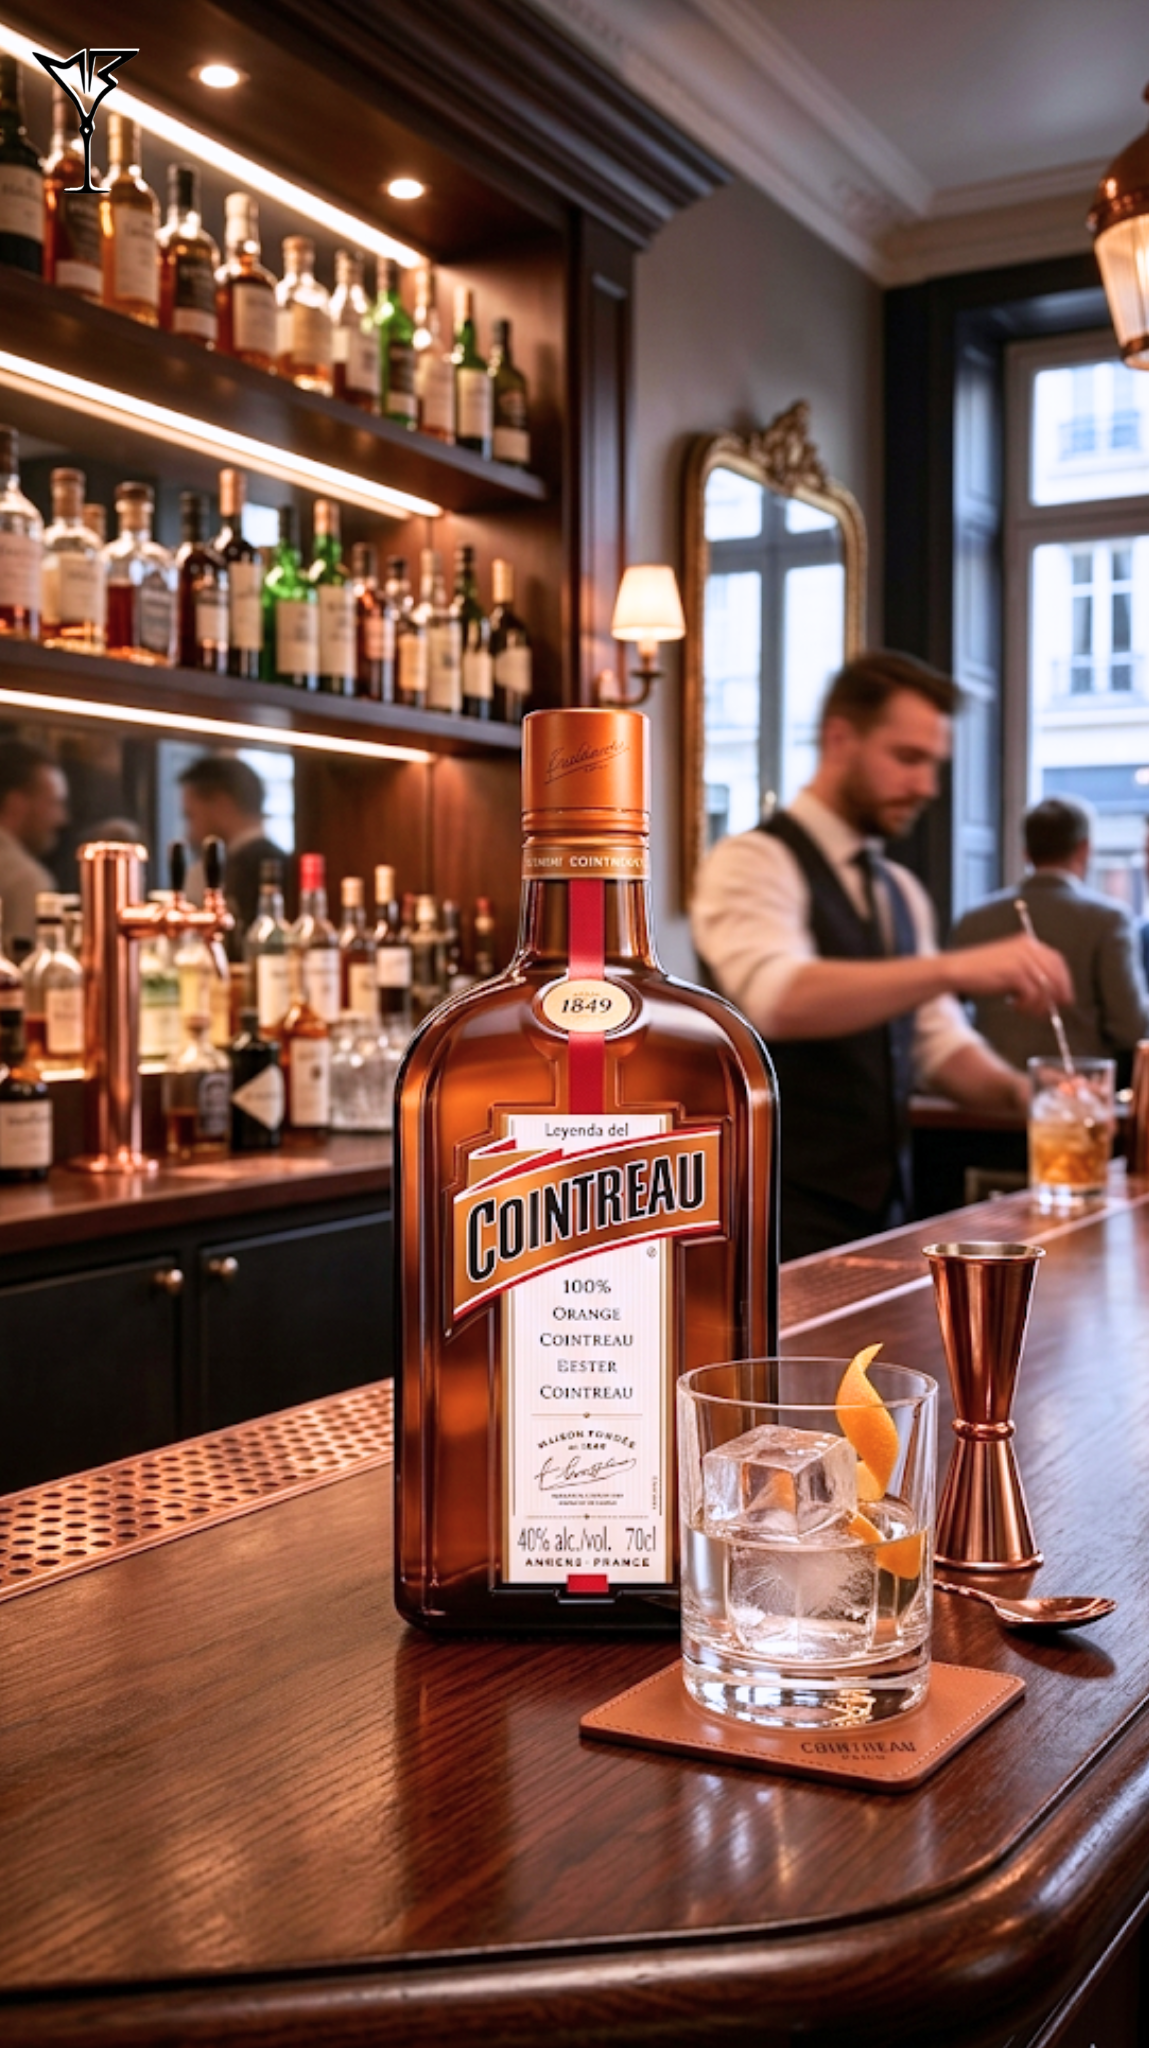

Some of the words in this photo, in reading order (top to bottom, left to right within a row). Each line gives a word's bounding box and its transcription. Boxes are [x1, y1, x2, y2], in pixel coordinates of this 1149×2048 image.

[562, 998, 612, 1014] 1849
[545, 1123, 603, 1141] Leyenda
[608, 1122, 629, 1137] del
[467, 1150, 705, 1283] COINTREAU
[563, 1279, 612, 1294] 100%
[552, 1306, 621, 1321] ORANGE
[539, 1333, 634, 1347] COINTREAU
[539, 1385, 634, 1400] COINTREAU
[517, 1527, 550, 1552] 40%
[625, 1526, 656, 1552] 70cl
